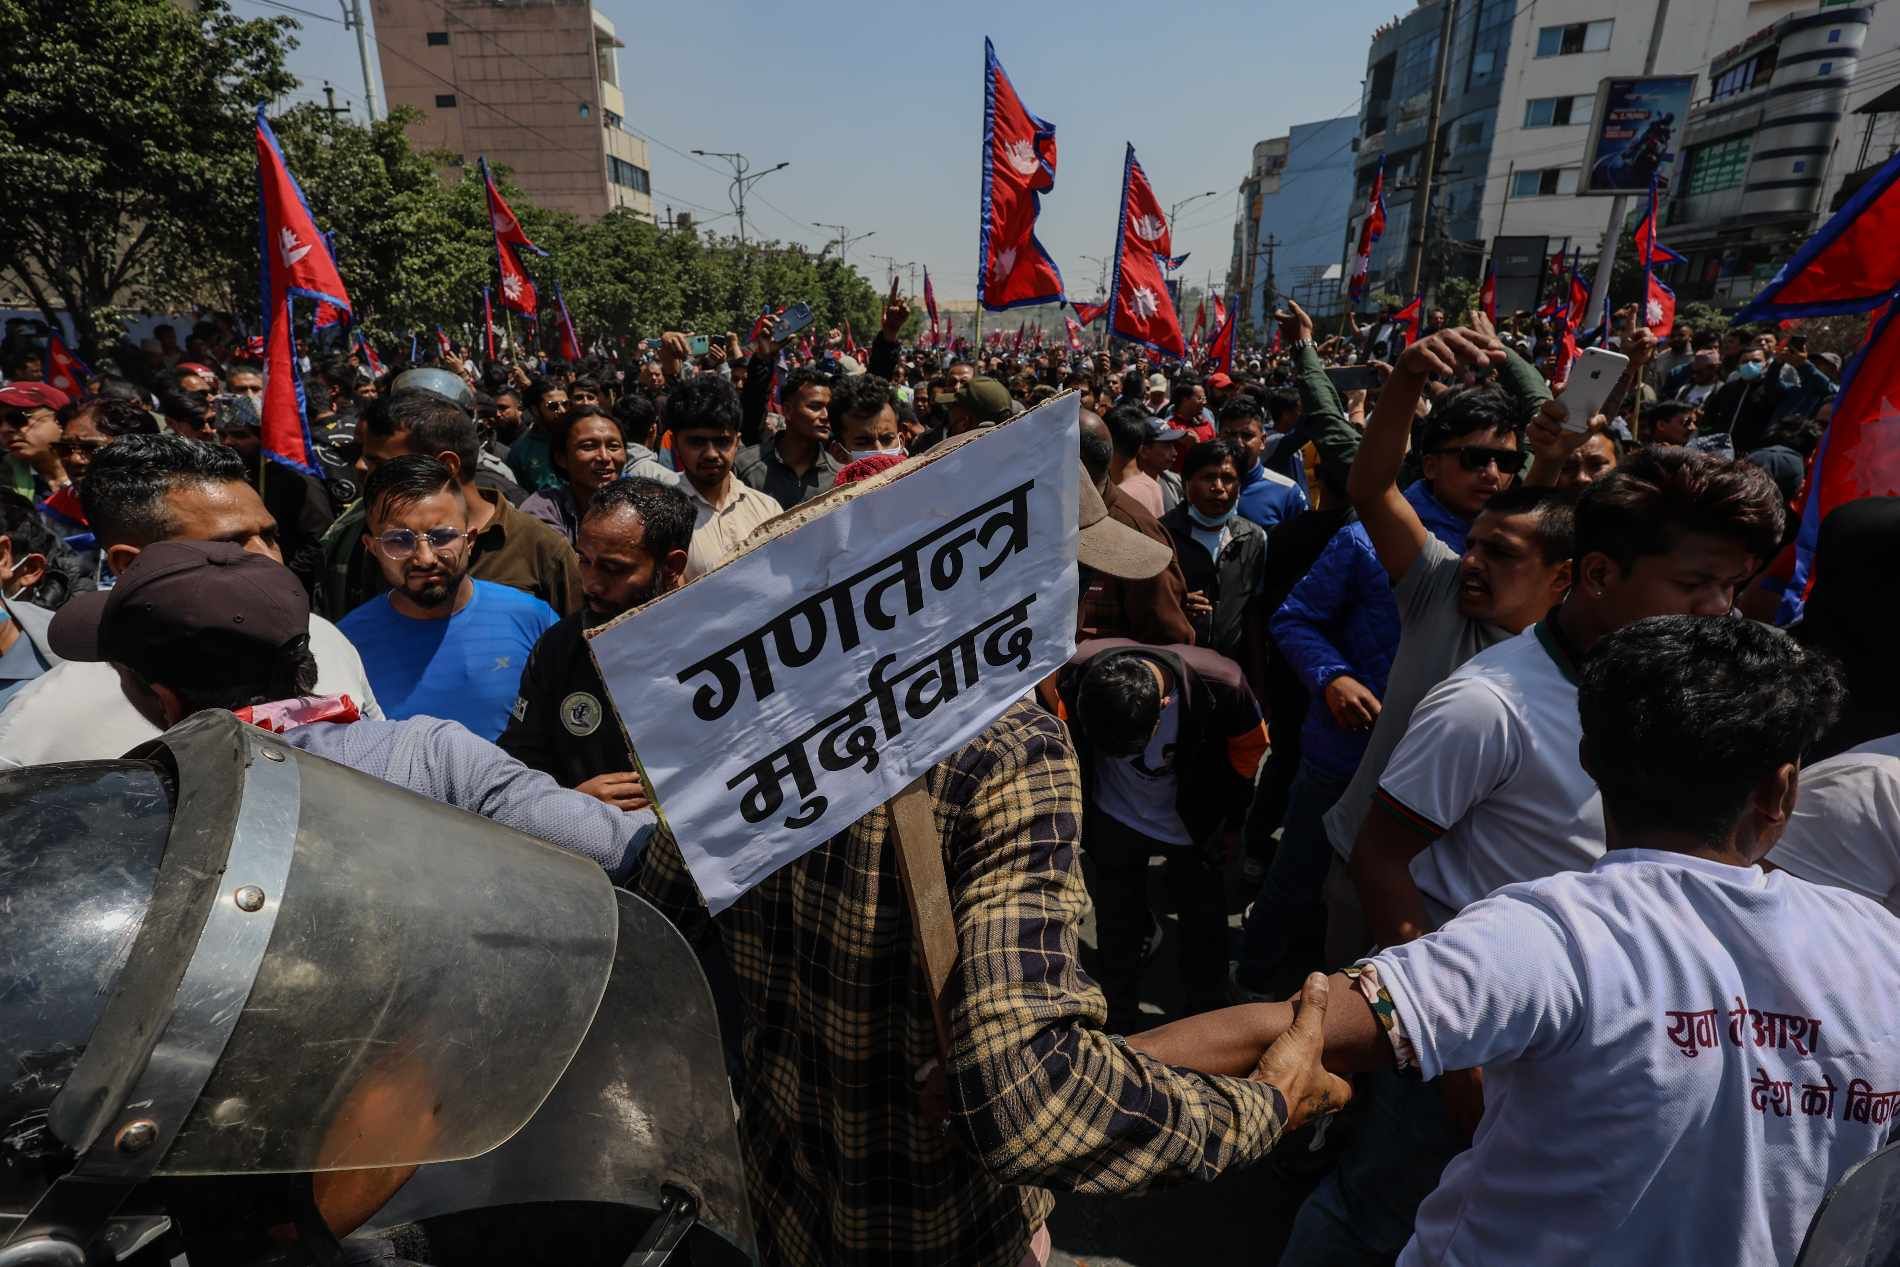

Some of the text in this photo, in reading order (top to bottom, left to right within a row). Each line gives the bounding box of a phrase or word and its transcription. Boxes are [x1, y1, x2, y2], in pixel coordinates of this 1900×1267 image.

[676, 479, 1034, 721] गणतन्त्र
[726, 593, 1037, 829] मुर्दावाद
[1665, 1009, 1719, 1057] युवा
[1751, 1067, 1793, 1117] देश
[1801, 1074, 1838, 1119] को
